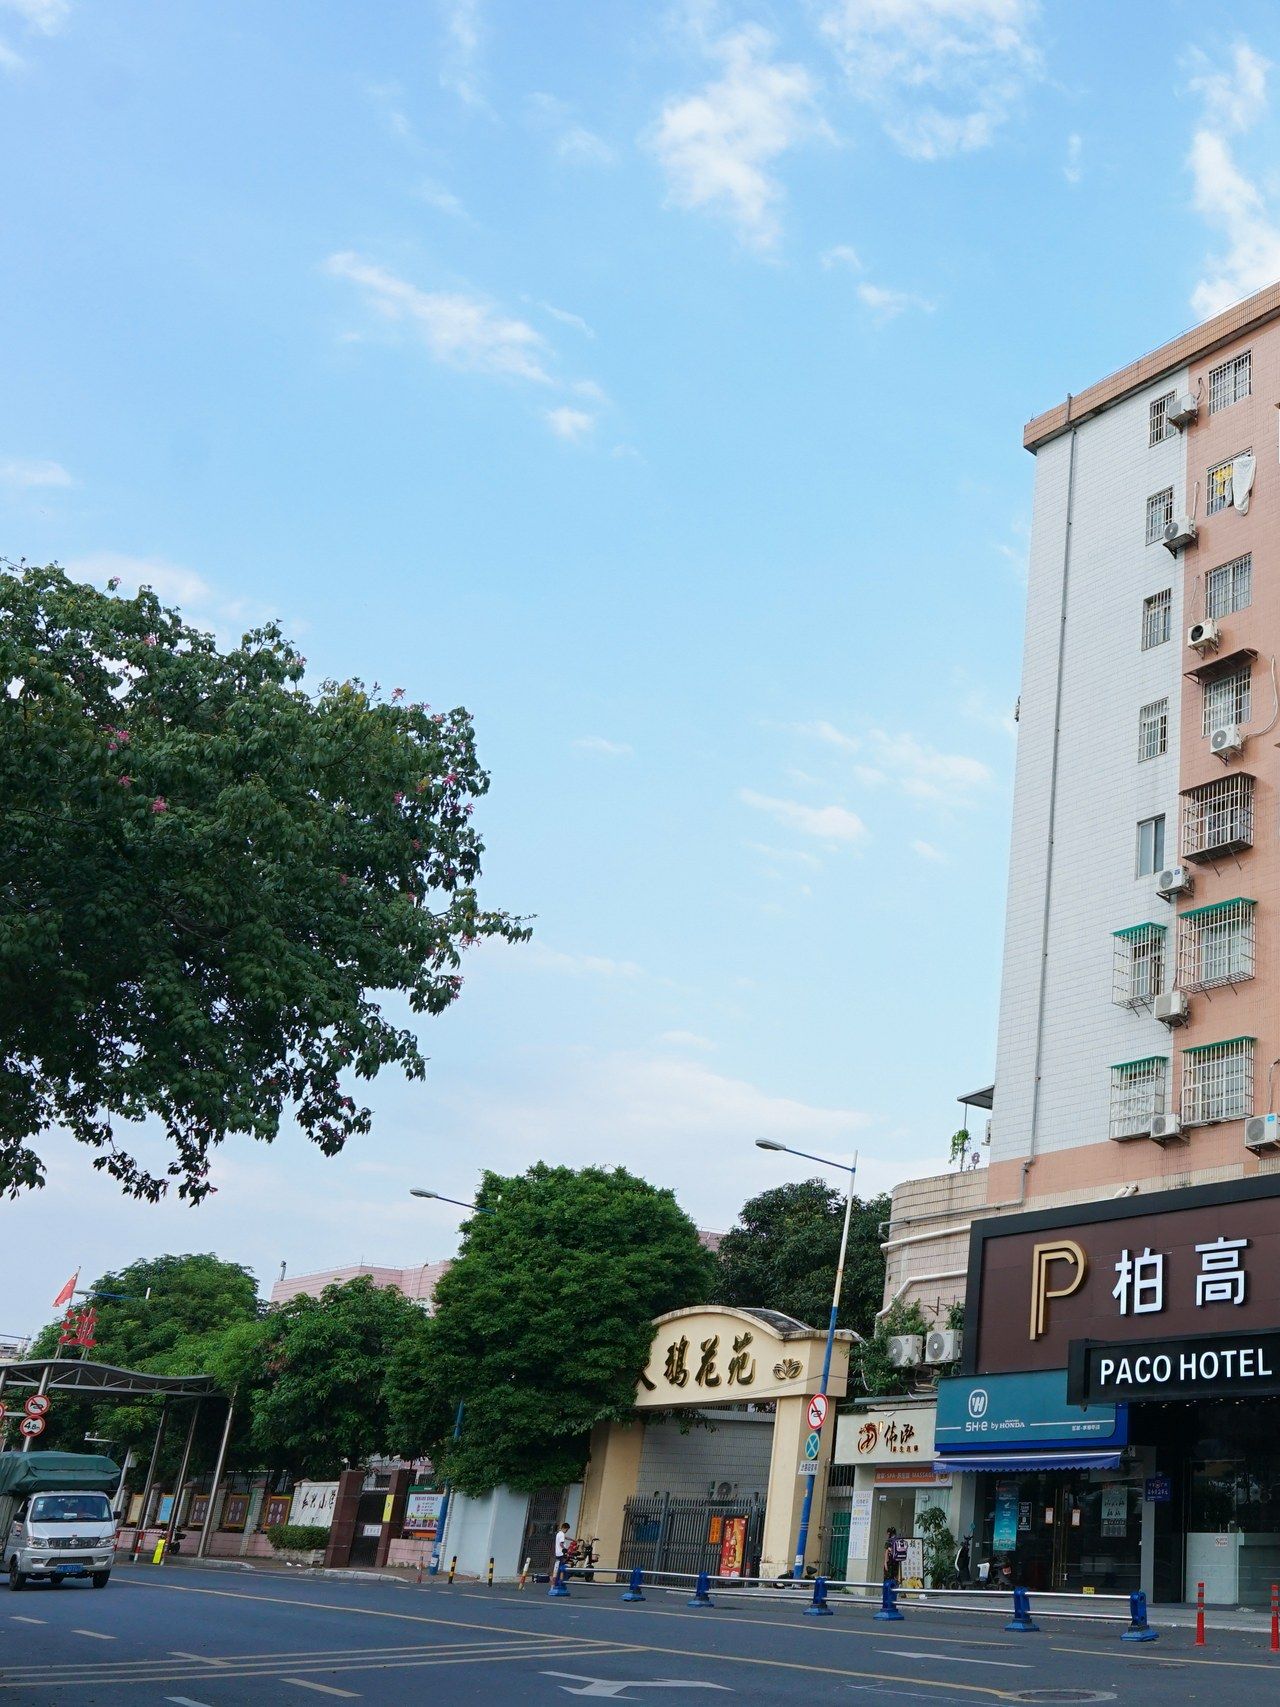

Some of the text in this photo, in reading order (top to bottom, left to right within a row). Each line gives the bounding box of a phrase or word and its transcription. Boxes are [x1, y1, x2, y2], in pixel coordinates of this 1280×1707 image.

[1100, 1348, 1273, 1385] PACO HOTEL
[991, 1422, 999, 1431] by
[999, 1421, 1025, 1429] HONDA
